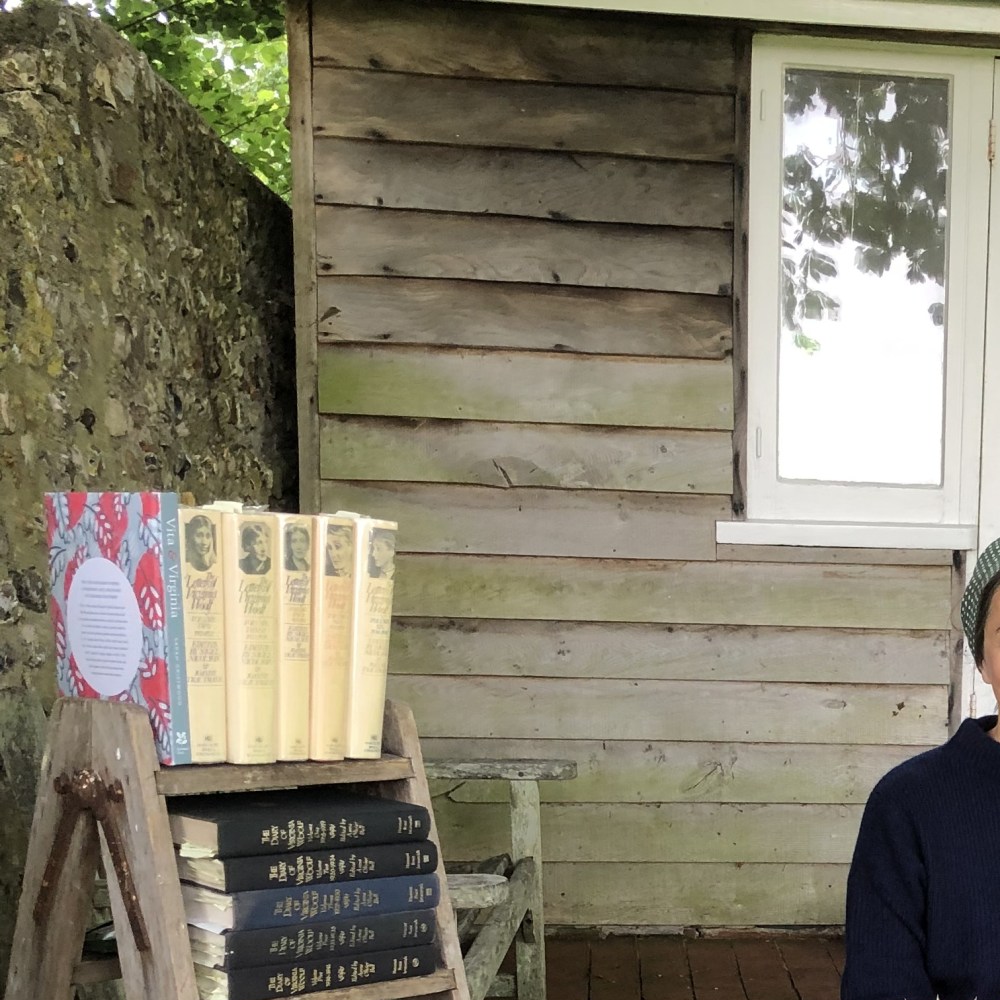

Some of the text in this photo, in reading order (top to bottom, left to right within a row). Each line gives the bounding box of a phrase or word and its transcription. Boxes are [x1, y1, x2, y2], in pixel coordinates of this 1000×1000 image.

[166, 518, 176, 545] Vita
[167, 565, 181, 618] Virginia
[269, 866, 278, 880] THE
[279, 861, 287, 882] DIARY
[296, 856, 304, 885] VIRGINIA
